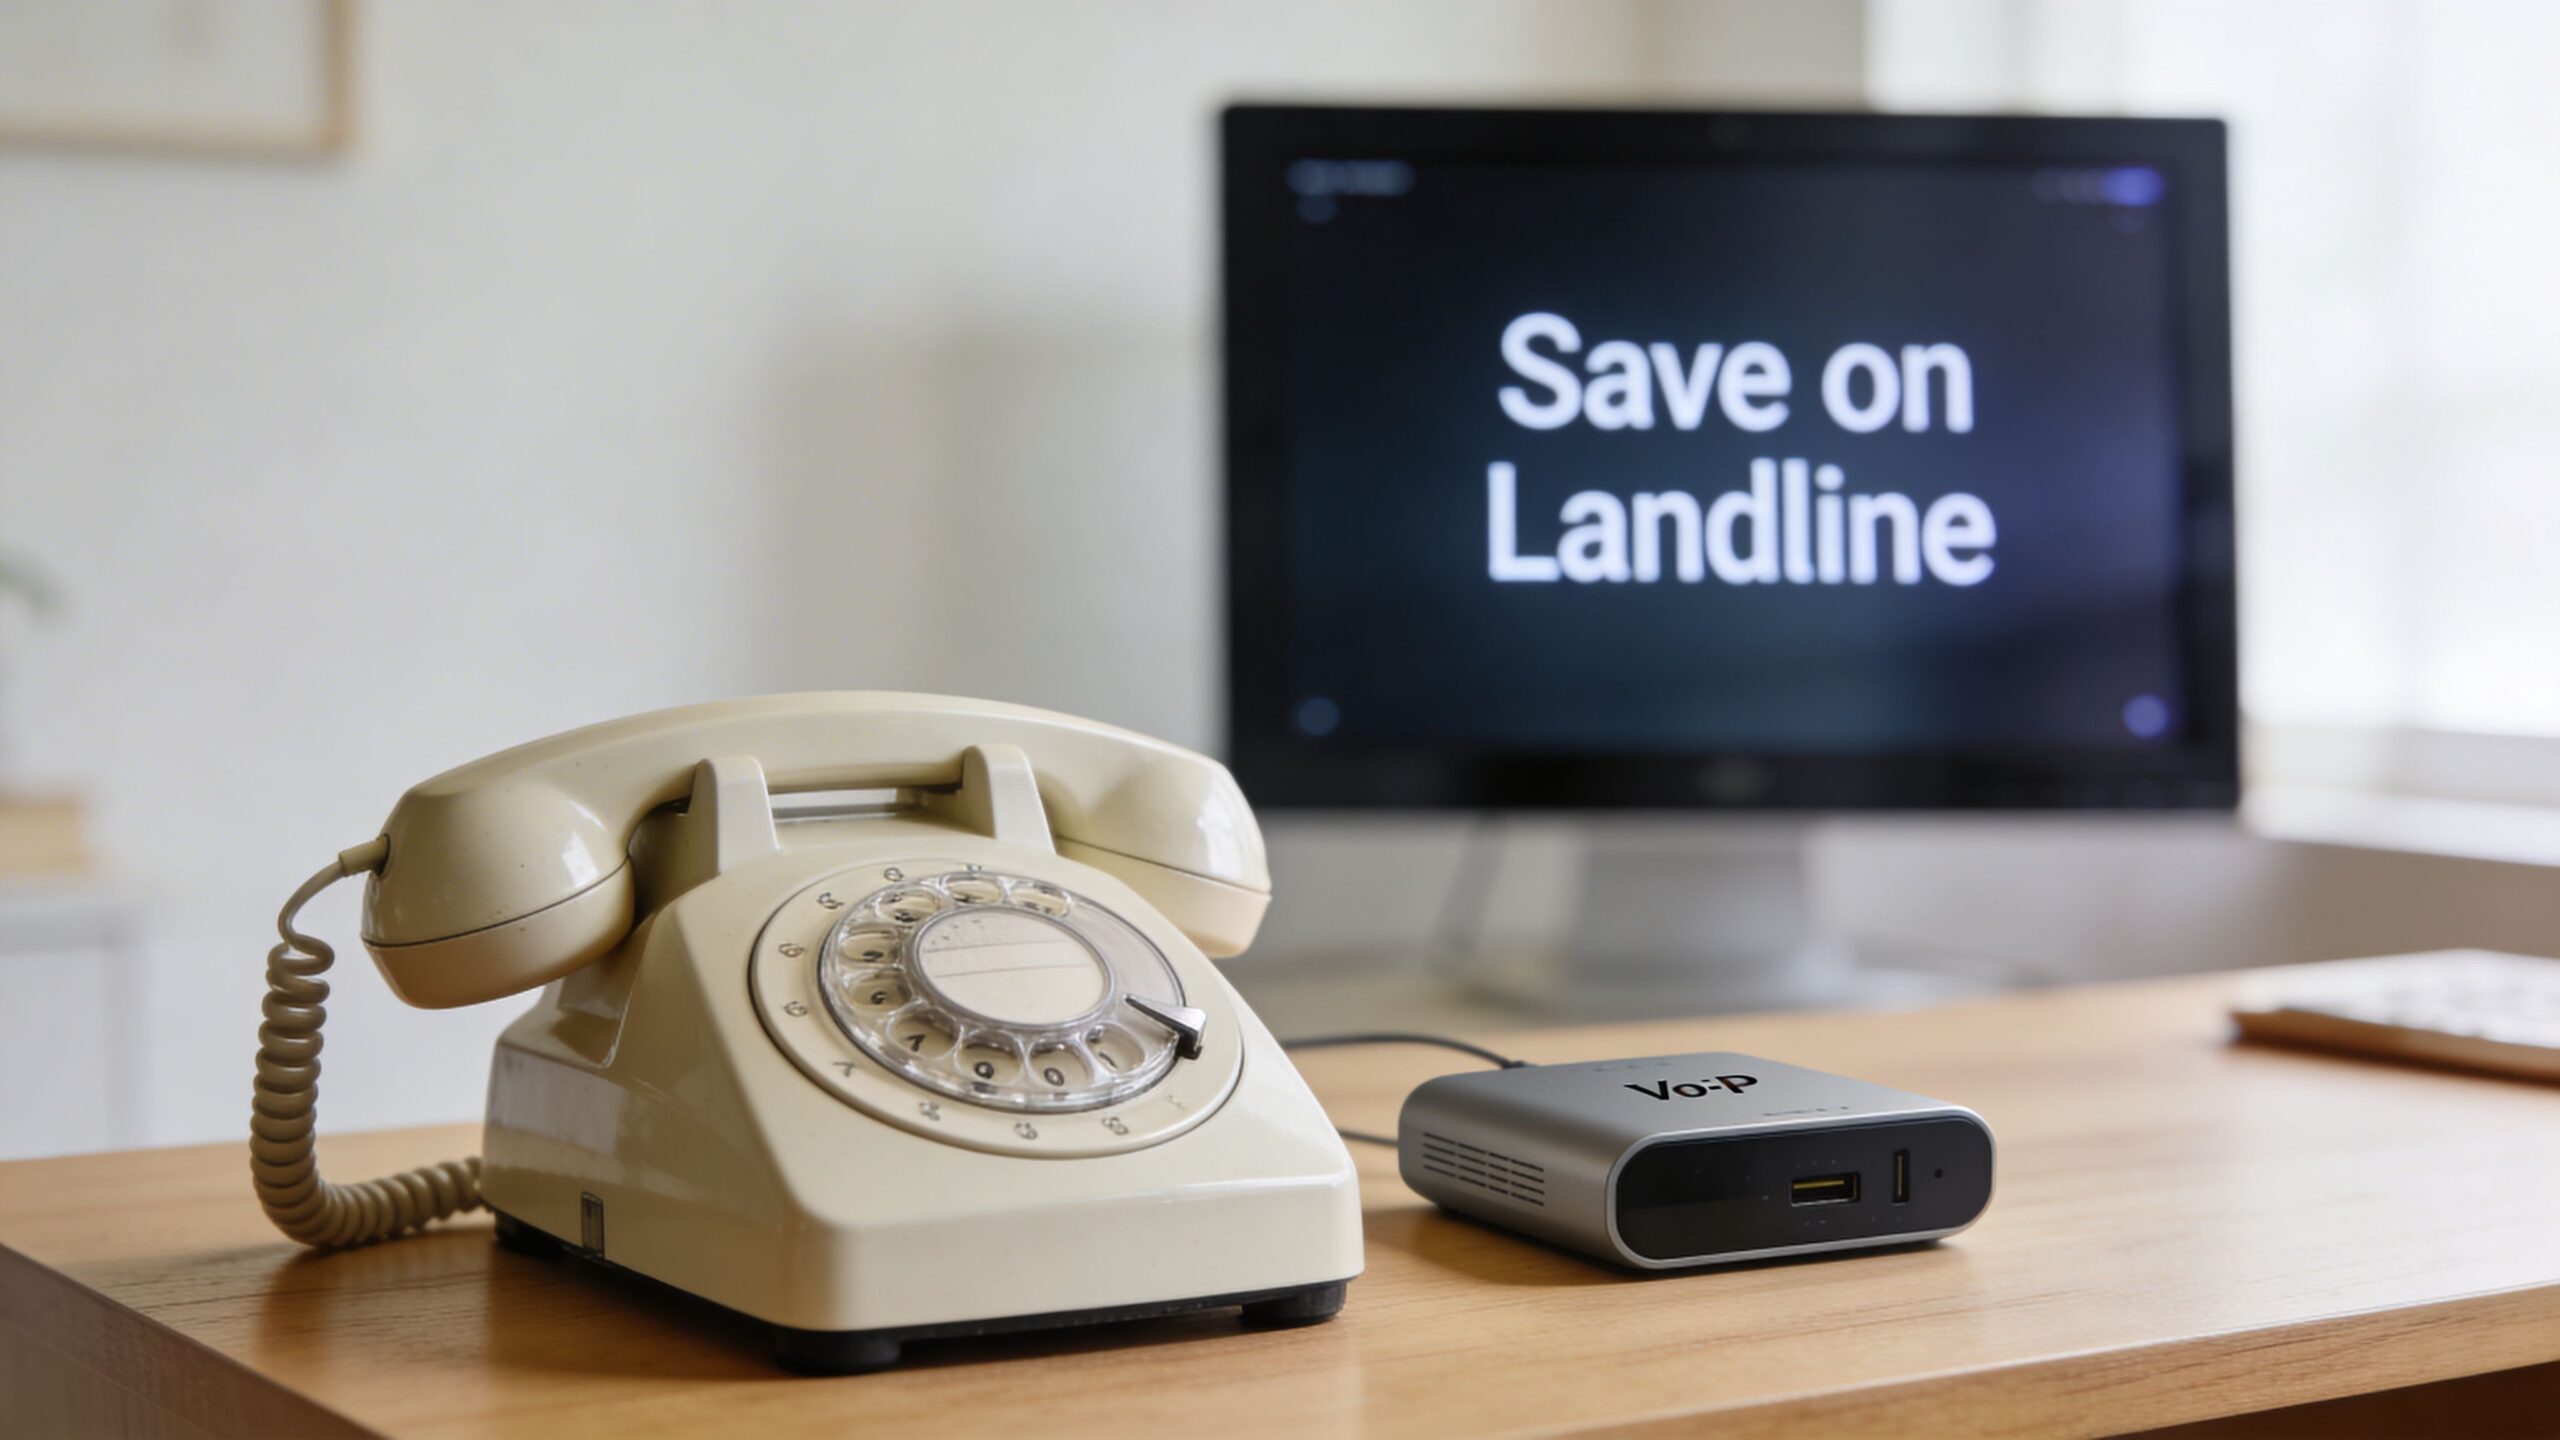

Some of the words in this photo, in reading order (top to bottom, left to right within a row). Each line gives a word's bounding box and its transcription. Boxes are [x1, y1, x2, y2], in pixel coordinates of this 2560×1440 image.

[1498, 312, 1792, 433] Save
[1821, 342, 1975, 434] on
[1487, 456, 1997, 587] Landline
